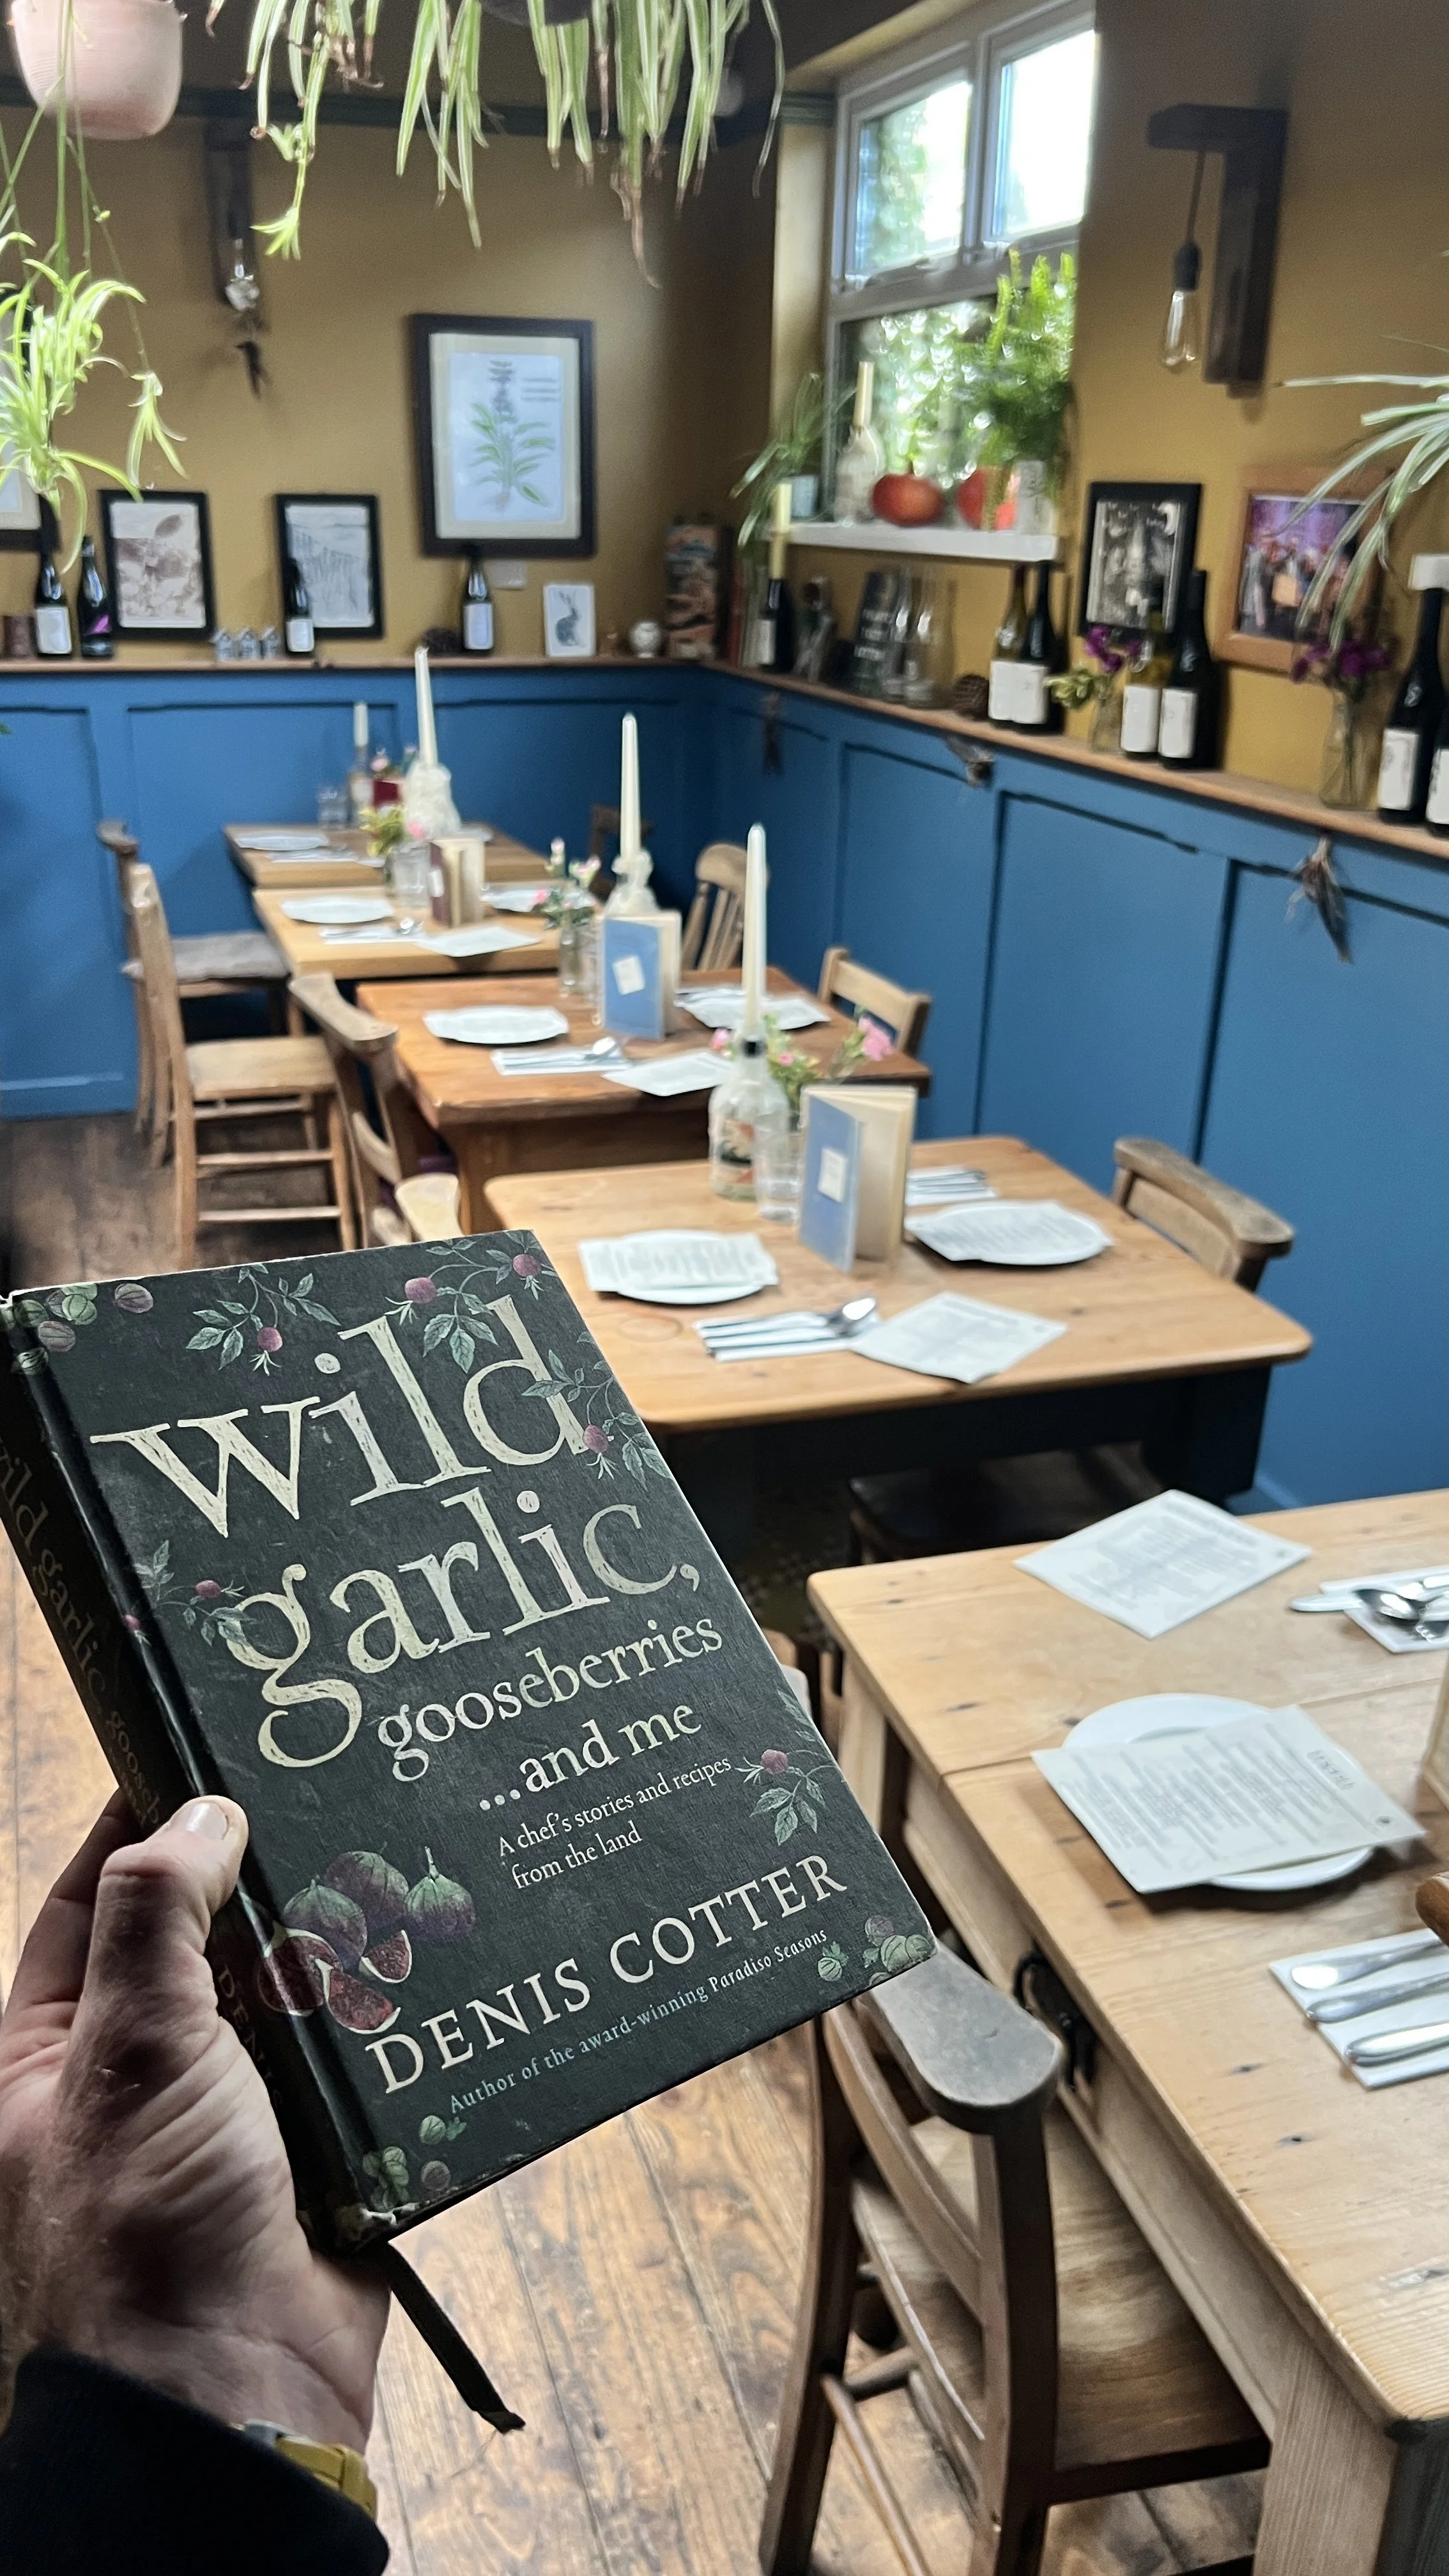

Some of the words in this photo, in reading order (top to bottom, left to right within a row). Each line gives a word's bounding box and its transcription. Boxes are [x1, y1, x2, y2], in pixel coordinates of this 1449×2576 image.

[90, 1294, 613, 1538] wild
[226, 1487, 700, 1767] garlic,
[378, 1618, 722, 1781] gooseberries
[479, 1719, 619, 1810] ...and
[618, 1705, 701, 1756] me
[500, 1837, 515, 1857] A
[518, 1813, 572, 1849] chef's
[575, 1794, 634, 1828] stories
[636, 1773, 673, 1804] and
[673, 1758, 732, 1789] recipes
[511, 1862, 564, 1890] from
[567, 1843, 599, 1869] the
[595, 1820, 643, 1855] land
[365, 1958, 590, 2094] DENIS
[610, 1855, 847, 1985] COTTER
[449, 2073, 518, 2114] Author
[521, 2057, 540, 2080] of
[542, 2044, 576, 2073] the
[579, 1982, 709, 2054] award-winning
[707, 1954, 772, 1994] Paradiso
[775, 1928, 829, 1968] Seasons
